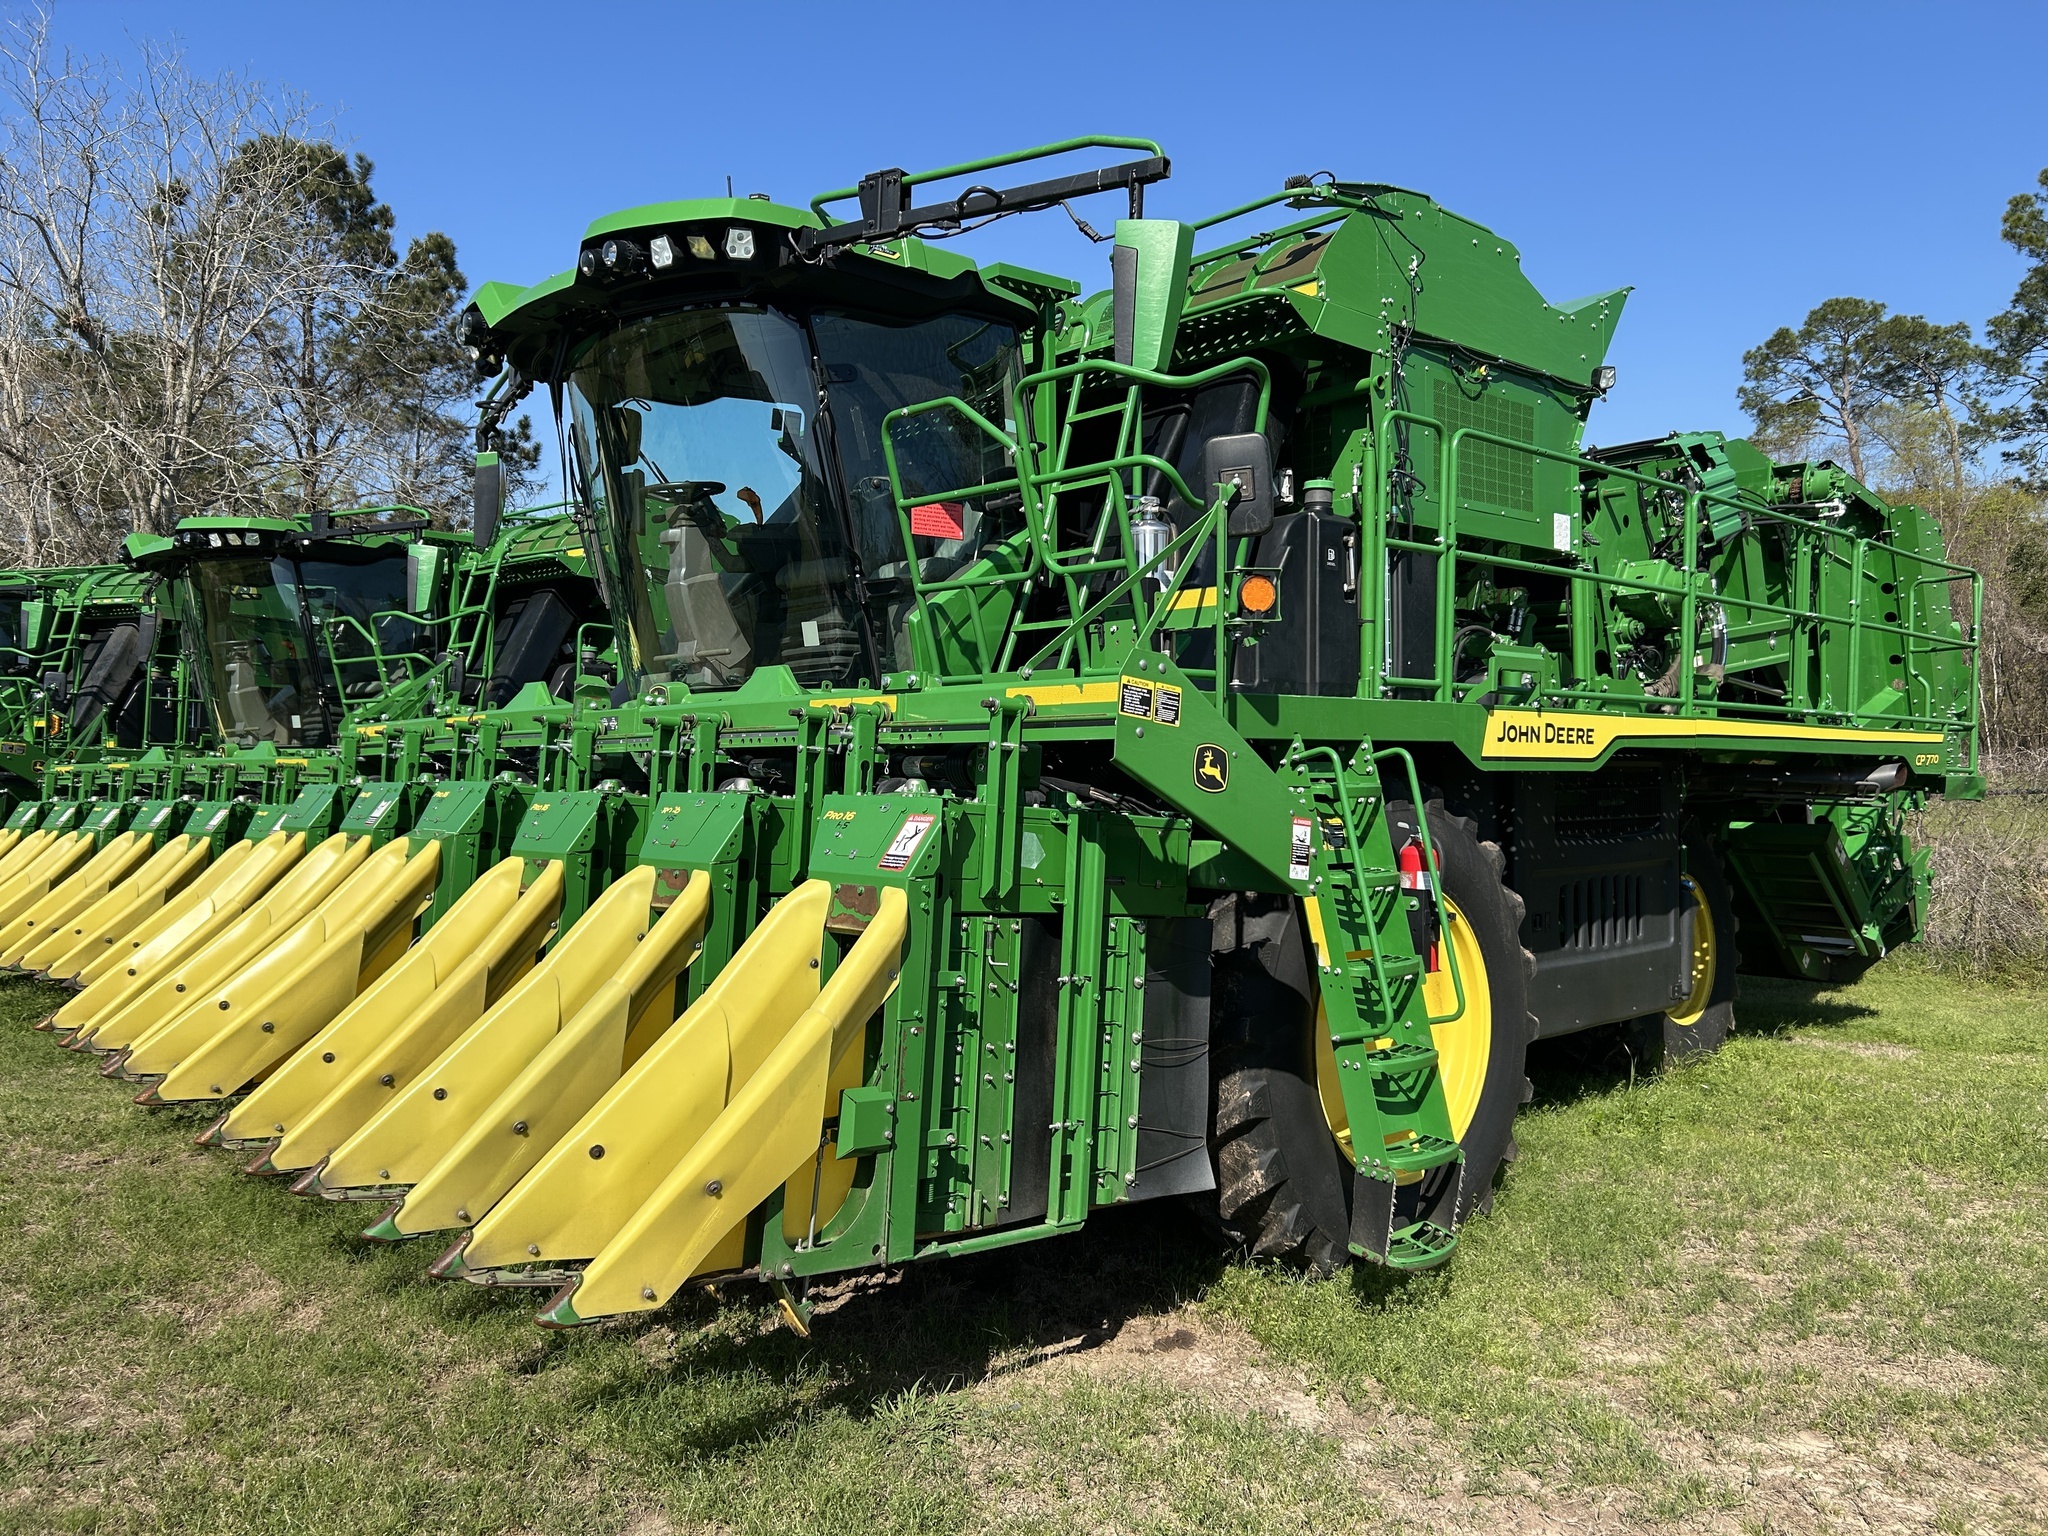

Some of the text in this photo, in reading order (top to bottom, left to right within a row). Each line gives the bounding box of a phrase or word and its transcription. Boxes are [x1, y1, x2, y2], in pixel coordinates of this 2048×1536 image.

[1497, 721, 1595, 745] JOHN DEERE
[1915, 754, 1939, 766] CP 770
